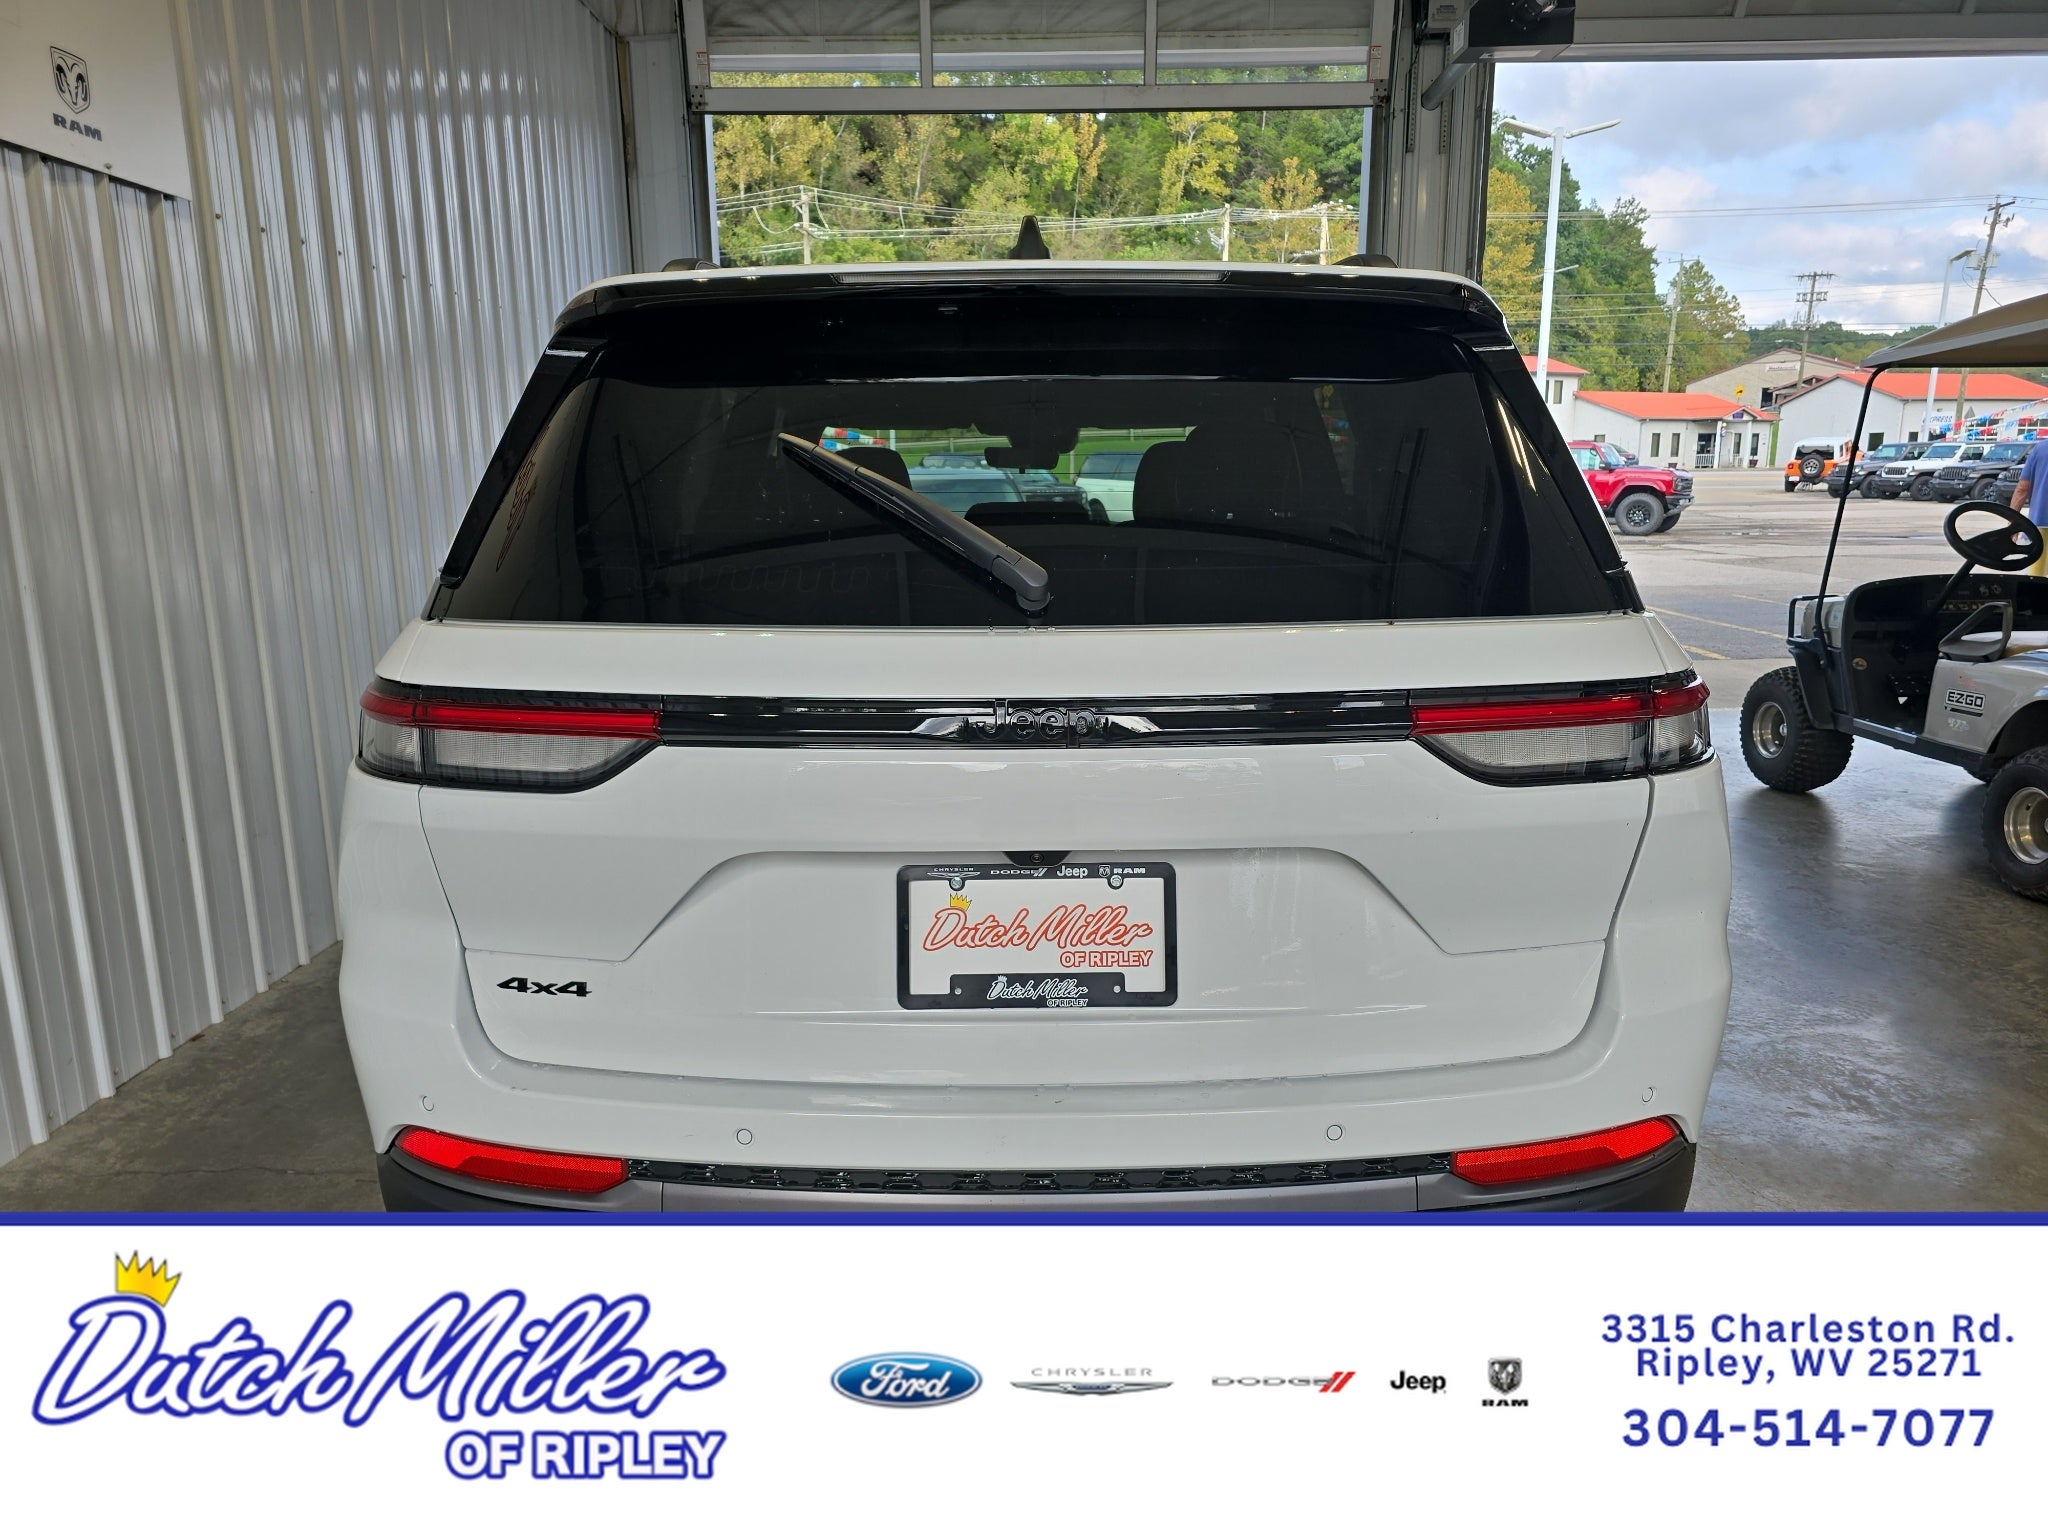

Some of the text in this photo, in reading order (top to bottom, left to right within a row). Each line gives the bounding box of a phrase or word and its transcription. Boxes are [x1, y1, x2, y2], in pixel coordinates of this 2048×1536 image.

[53, 112, 102, 142] RAM
[976, 698, 1096, 749] Jeep
[1057, 865, 1088, 879] Jeep
[923, 903, 1153, 951] Dutch Miller
[1060, 950, 1153, 968] OF RIPLEY
[496, 977, 592, 997] 4x4
[987, 978, 1088, 1000] Dutch Miller
[1047, 999, 1088, 1007] OF RIPLEY
